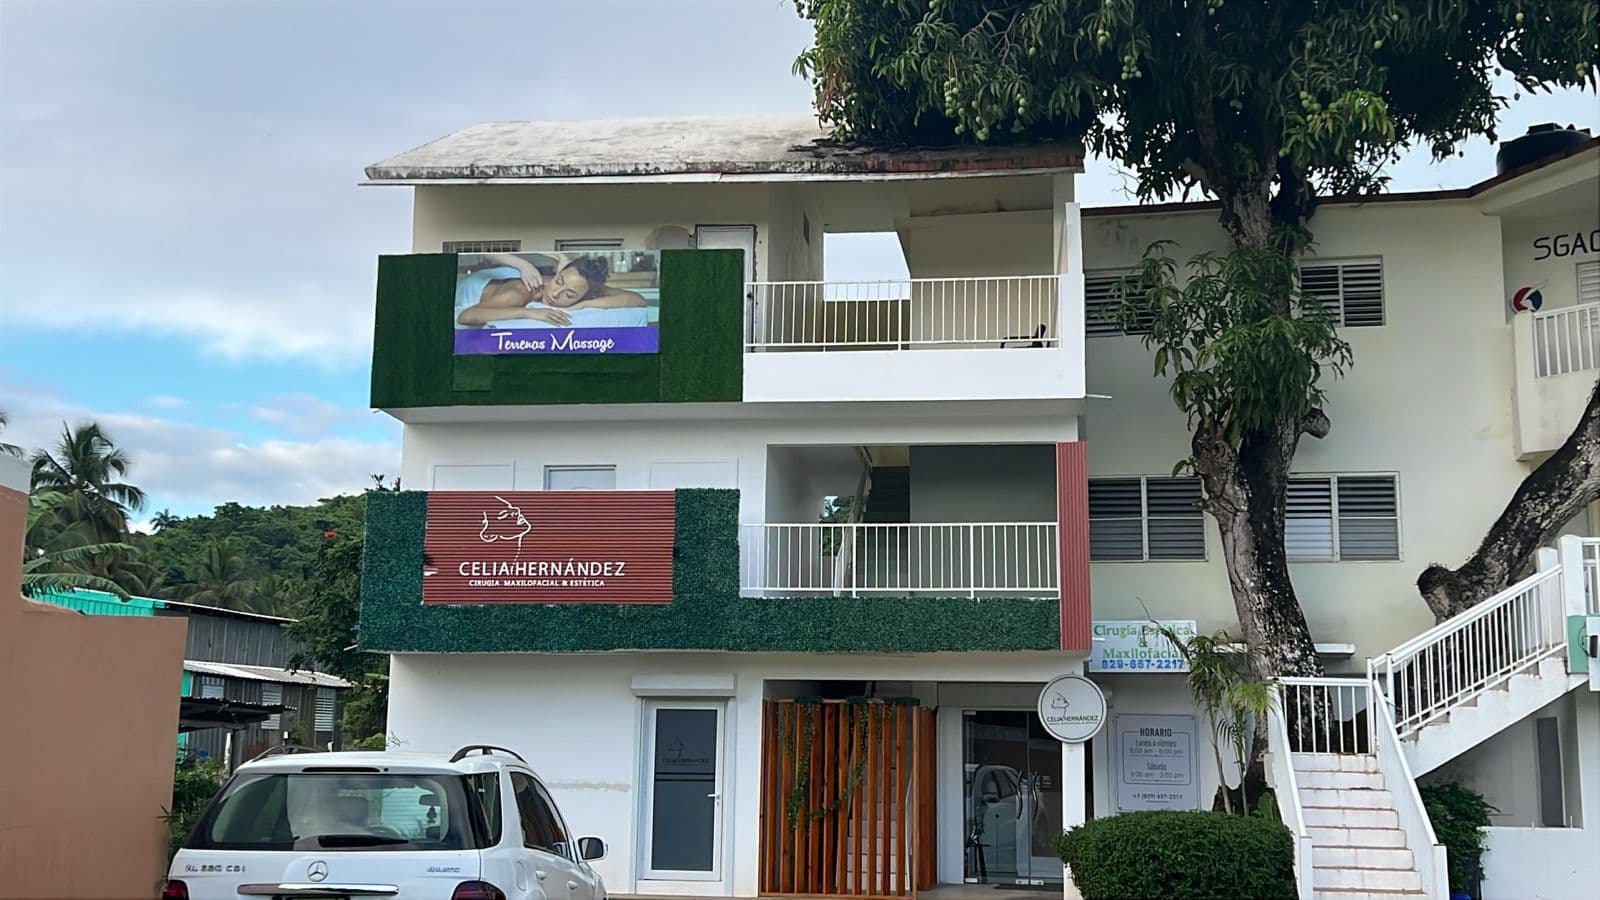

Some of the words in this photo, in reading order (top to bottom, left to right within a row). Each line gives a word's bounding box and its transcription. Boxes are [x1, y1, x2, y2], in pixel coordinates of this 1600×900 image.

[490, 331, 546, 350] Terrenas
[550, 329, 616, 352] Massage
[459, 561, 508, 577] CELIA
[515, 557, 626, 577] HERNÁNDEZ
[503, 579, 559, 588] MAXILOFACIAL
[561, 579, 569, 587] &
[1093, 624, 1137, 638] Cirugía
[1139, 727, 1173, 737] HORARIO
